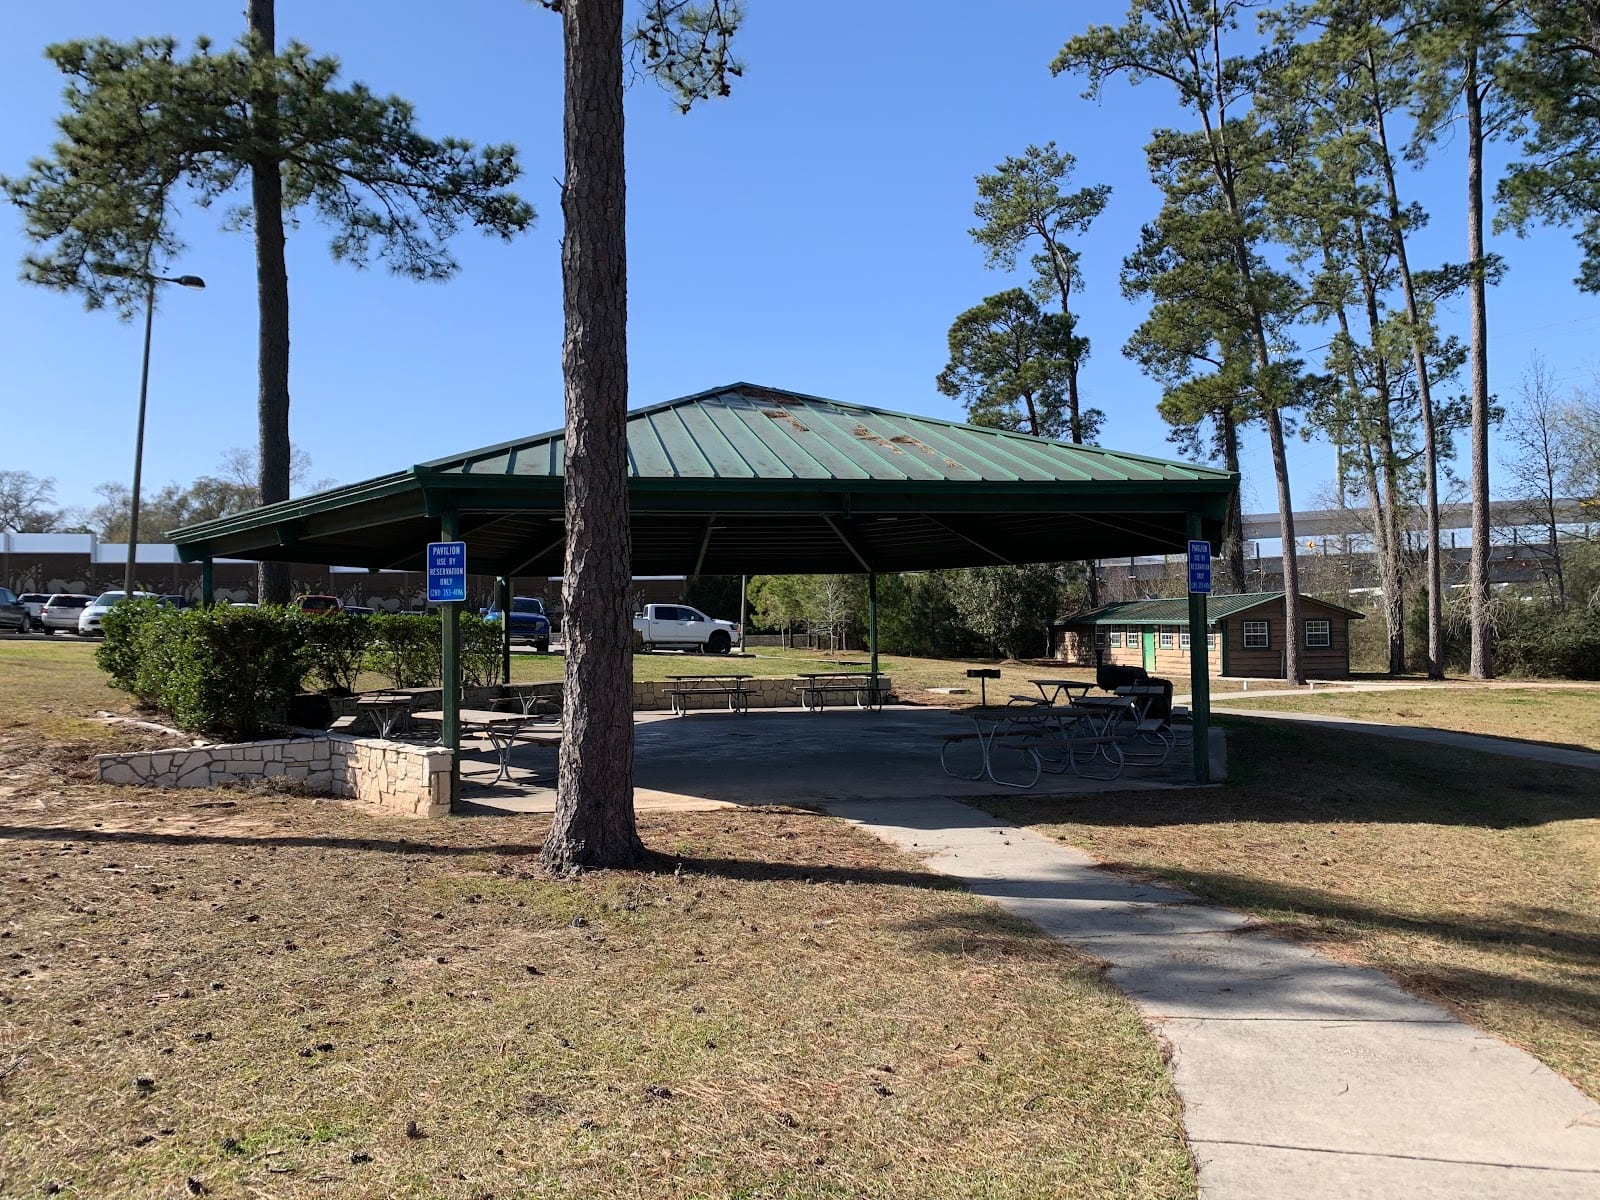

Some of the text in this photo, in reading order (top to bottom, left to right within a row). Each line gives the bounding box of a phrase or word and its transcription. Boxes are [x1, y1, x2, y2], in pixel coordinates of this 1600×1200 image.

[432, 546, 460, 556] PAVILION
[436, 558, 446, 566] USE
[430, 568, 464, 576] RESERVATION
[440, 578, 453, 586] ONLY
